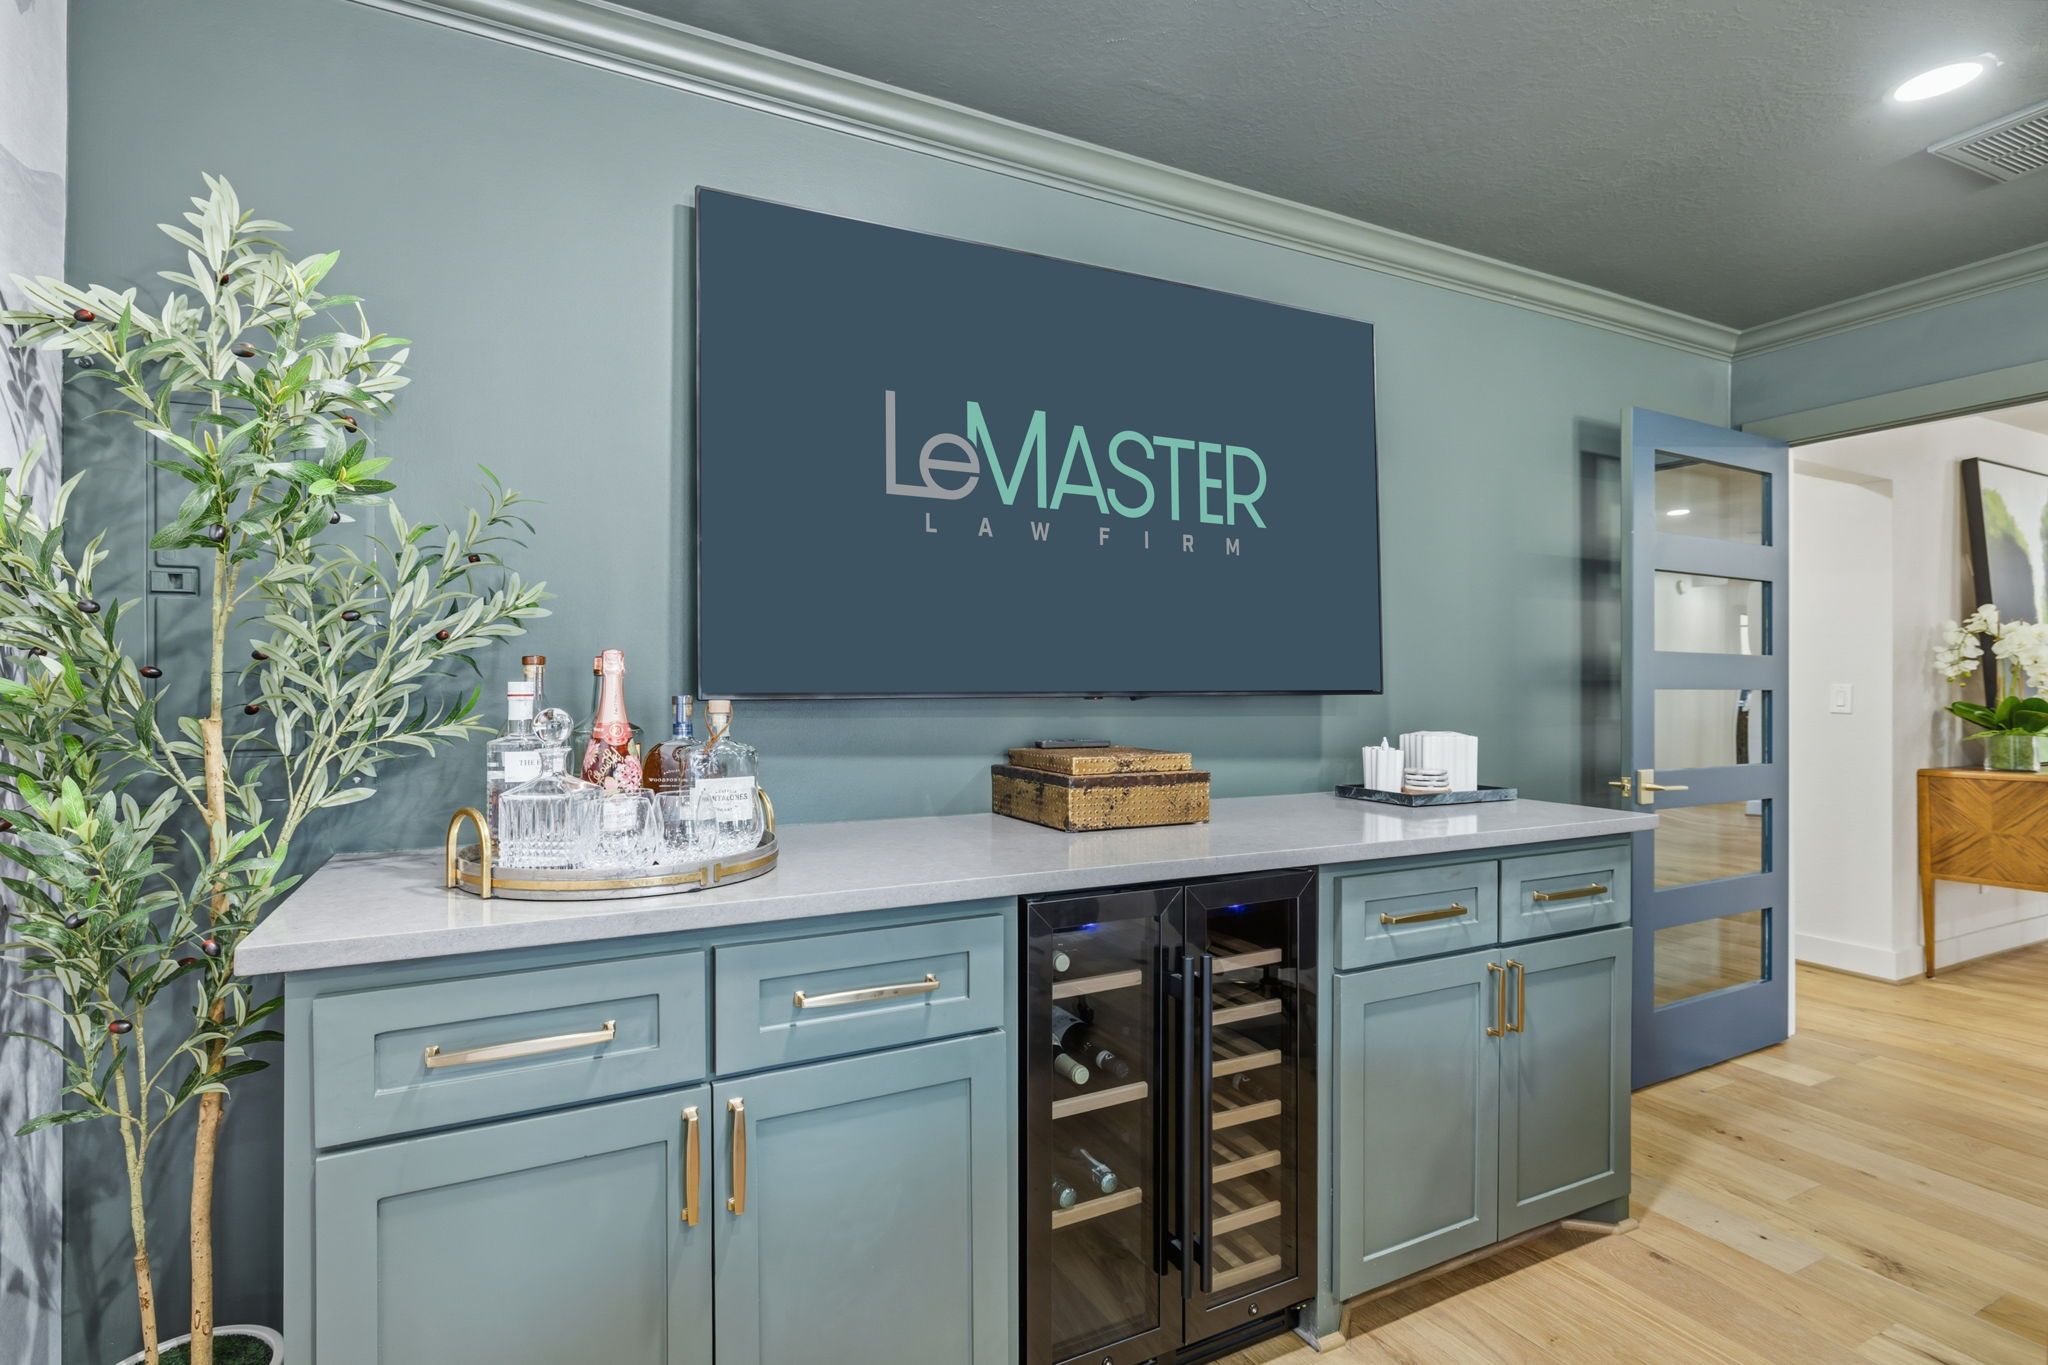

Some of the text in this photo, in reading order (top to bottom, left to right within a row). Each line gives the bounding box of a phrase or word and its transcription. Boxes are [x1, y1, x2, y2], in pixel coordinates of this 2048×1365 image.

[885, 390, 1267, 528] LeMASTER
[925, 512, 1240, 556] LAW FIRM
